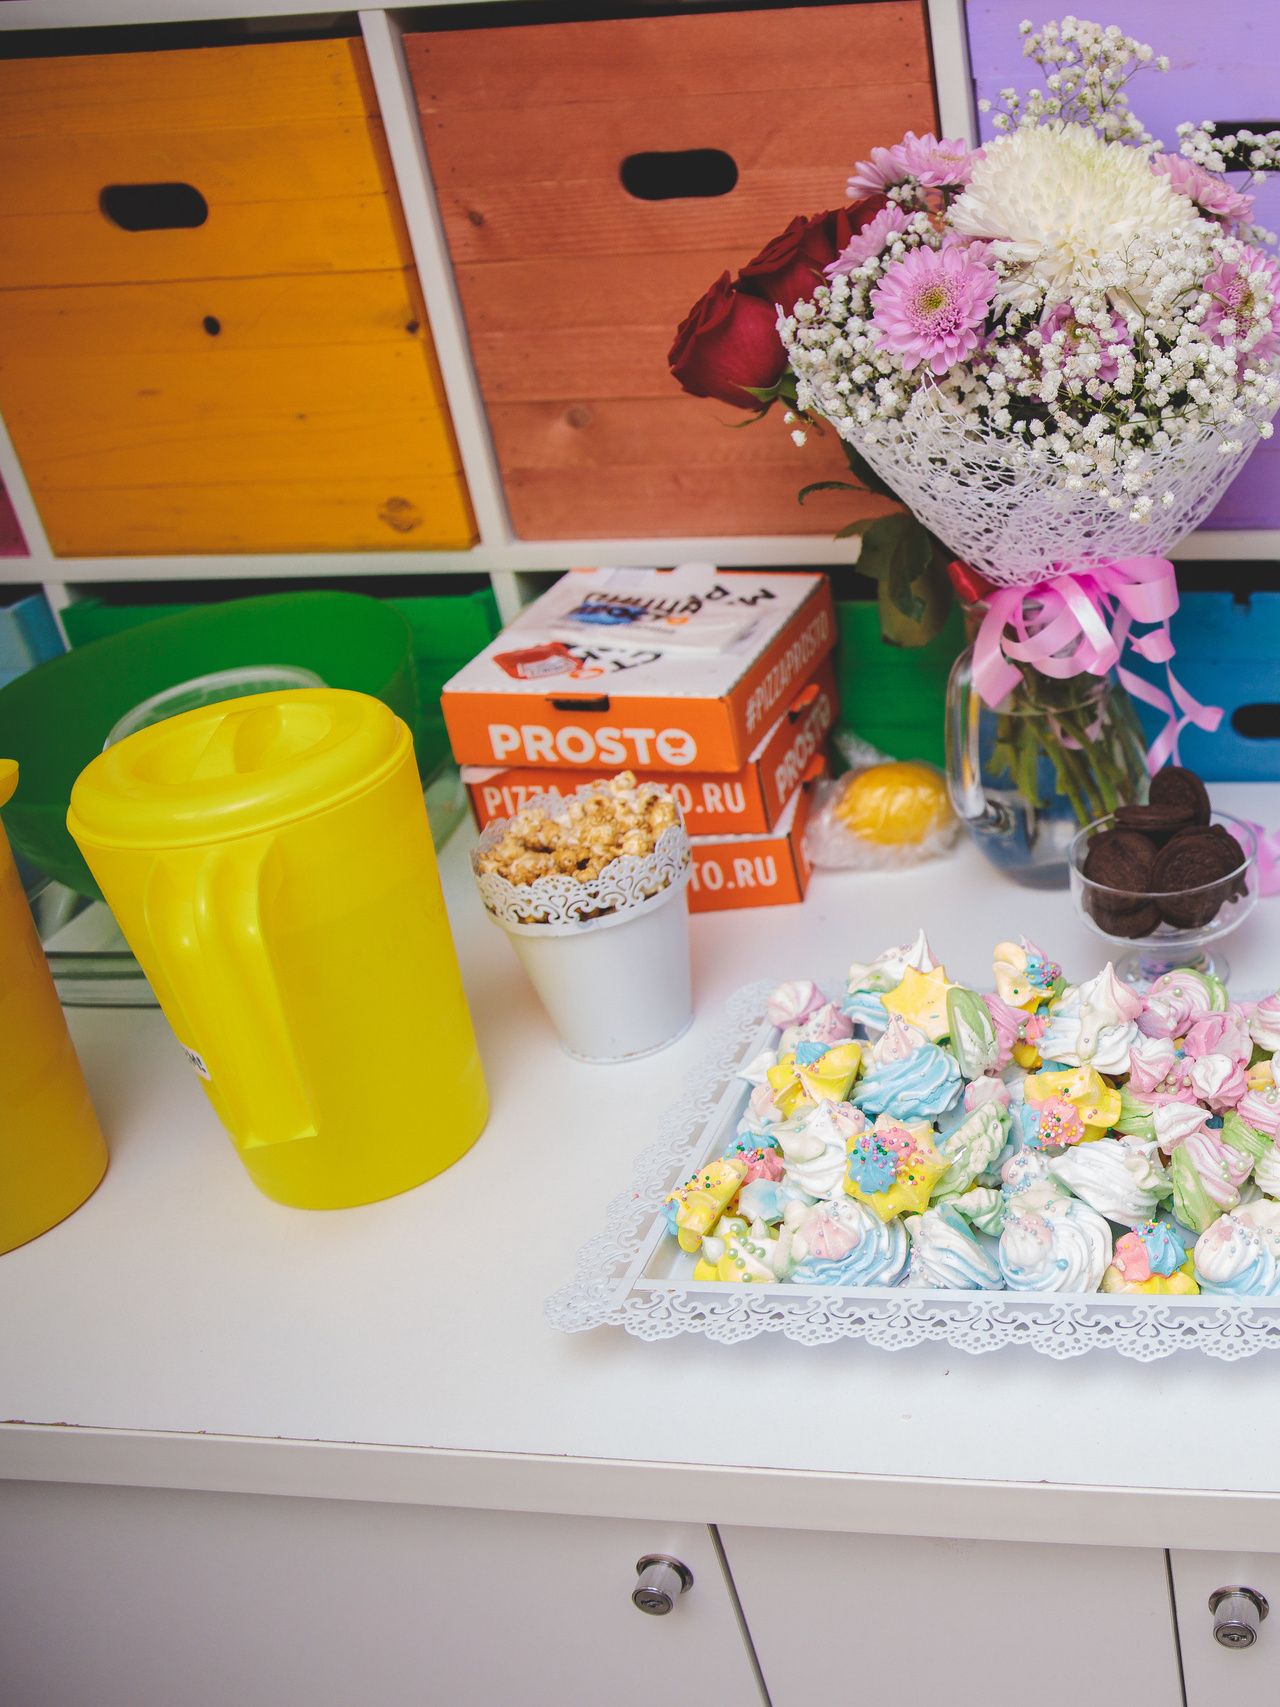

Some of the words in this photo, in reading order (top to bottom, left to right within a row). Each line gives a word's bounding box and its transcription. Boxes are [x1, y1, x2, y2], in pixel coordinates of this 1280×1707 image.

[746, 610, 829, 734] #PIZZAPROSTO
[487, 723, 698, 767] PROSTO
[775, 694, 832, 804] PROSTO
